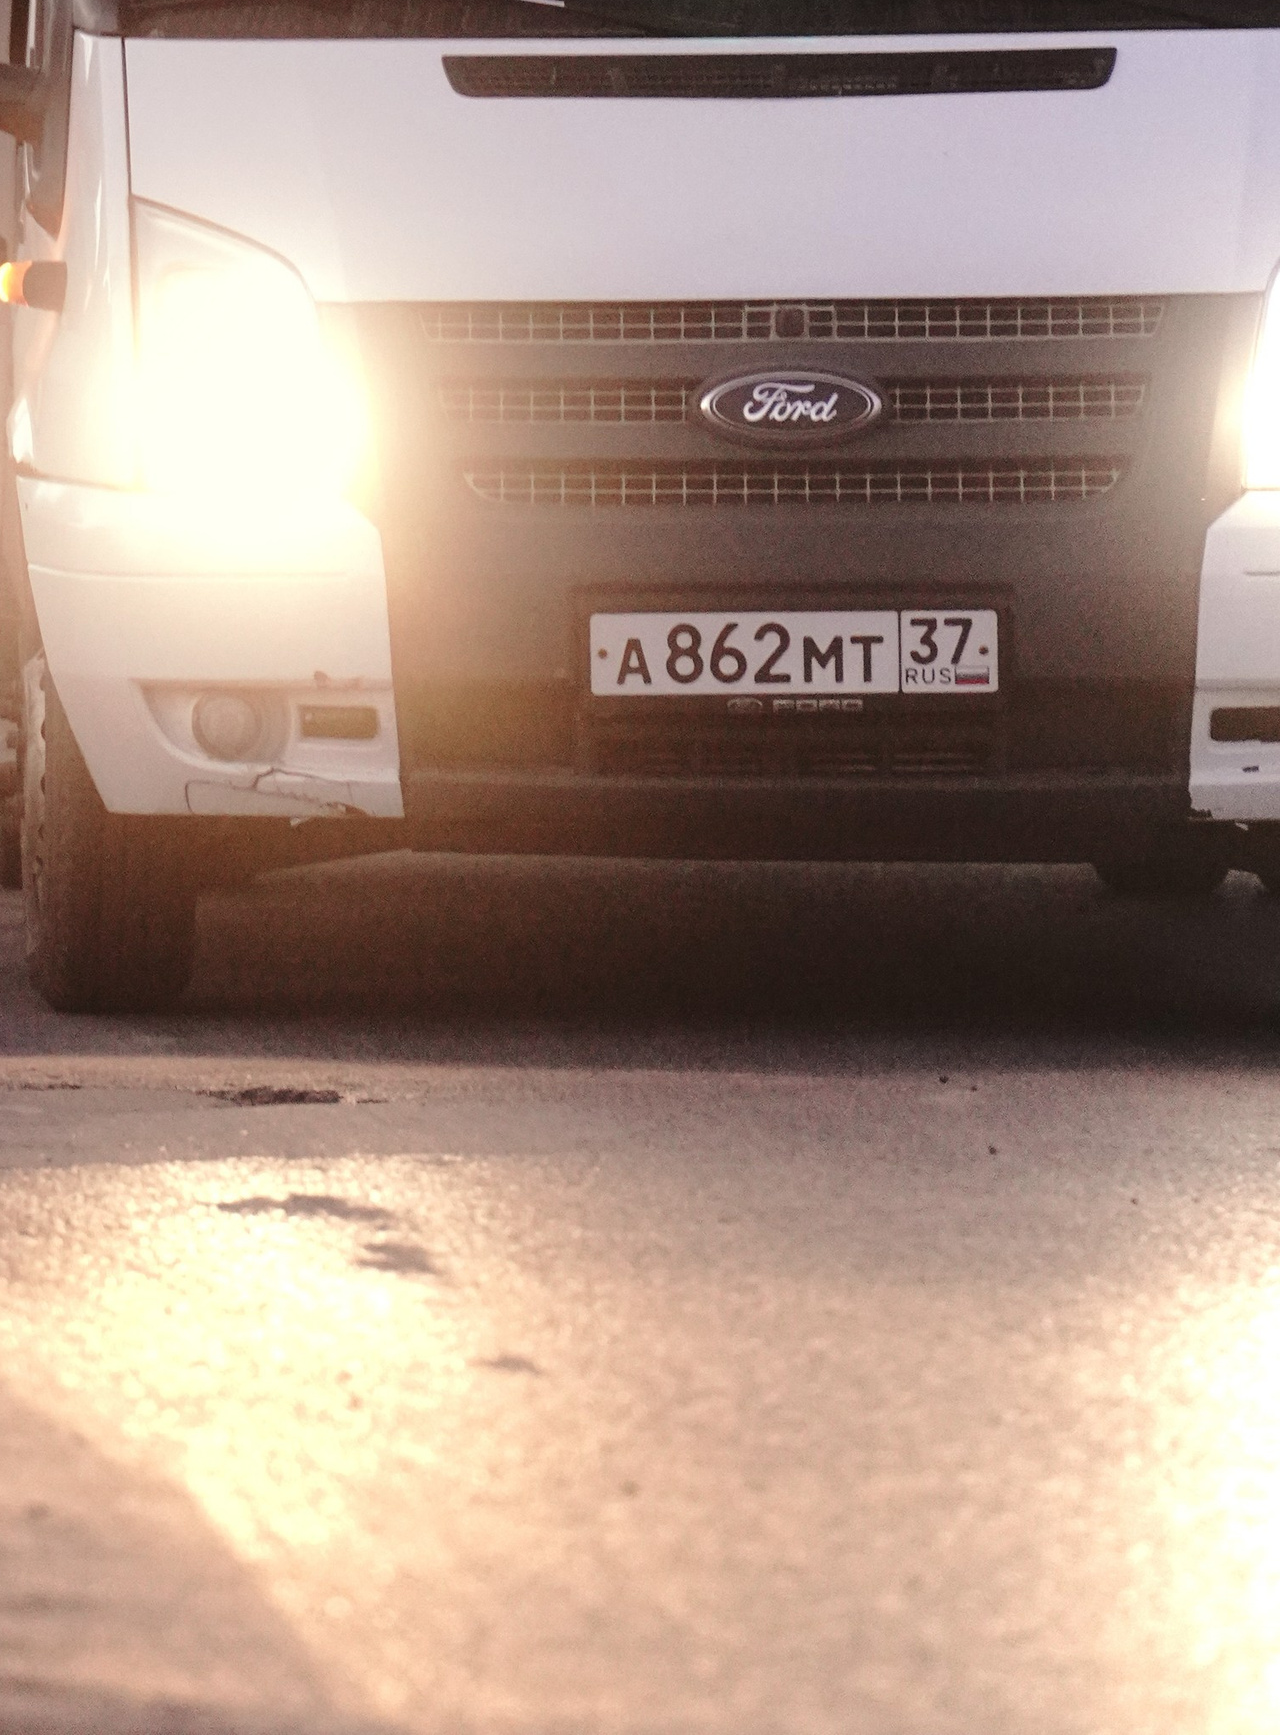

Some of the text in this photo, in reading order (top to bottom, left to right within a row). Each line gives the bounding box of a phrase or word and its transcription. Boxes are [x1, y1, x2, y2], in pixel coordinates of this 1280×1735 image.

[742, 381, 839, 423] Ford
[909, 617, 974, 665] 37
[904, 667, 952, 686] RUS
